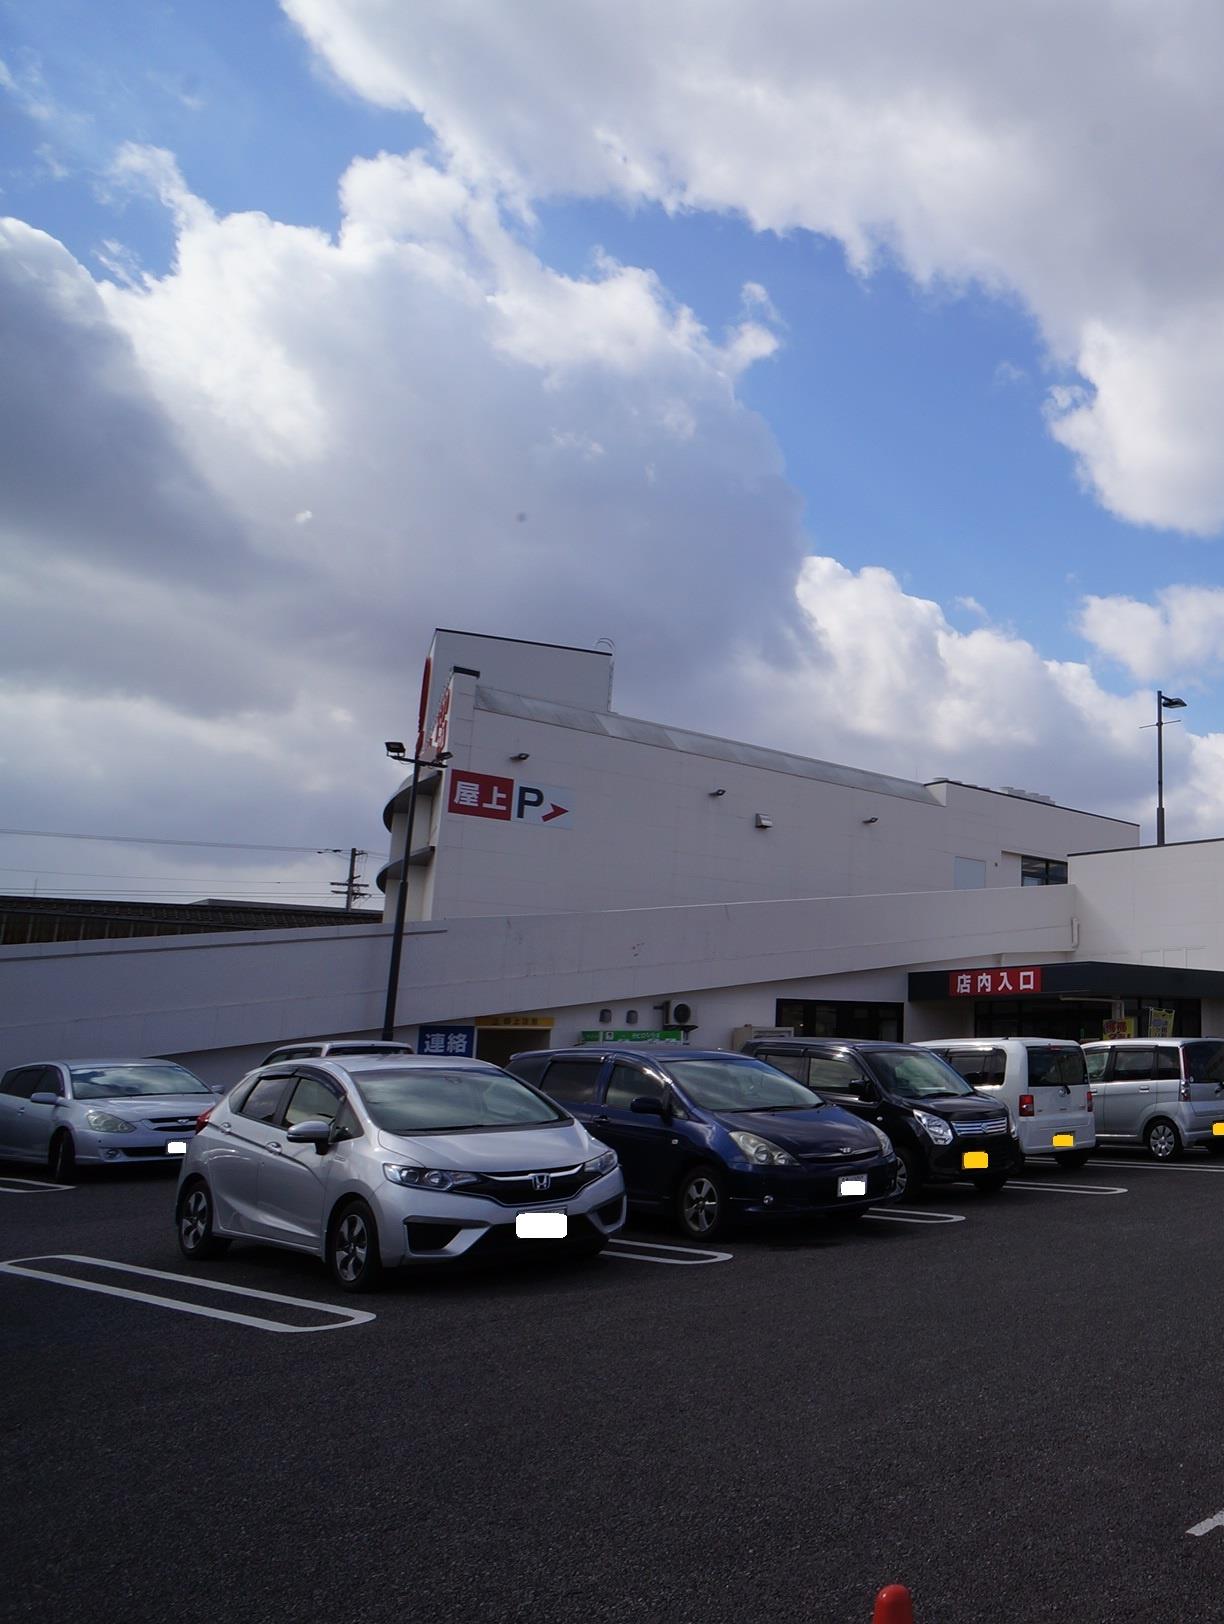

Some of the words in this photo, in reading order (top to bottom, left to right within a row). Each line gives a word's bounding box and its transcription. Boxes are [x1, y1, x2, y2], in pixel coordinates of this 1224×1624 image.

[454, 781, 507, 810] 屋上
[517, 786, 544, 819] P
[957, 971, 1034, 993] 店内入口
[424, 1033, 468, 1053] 連絡
